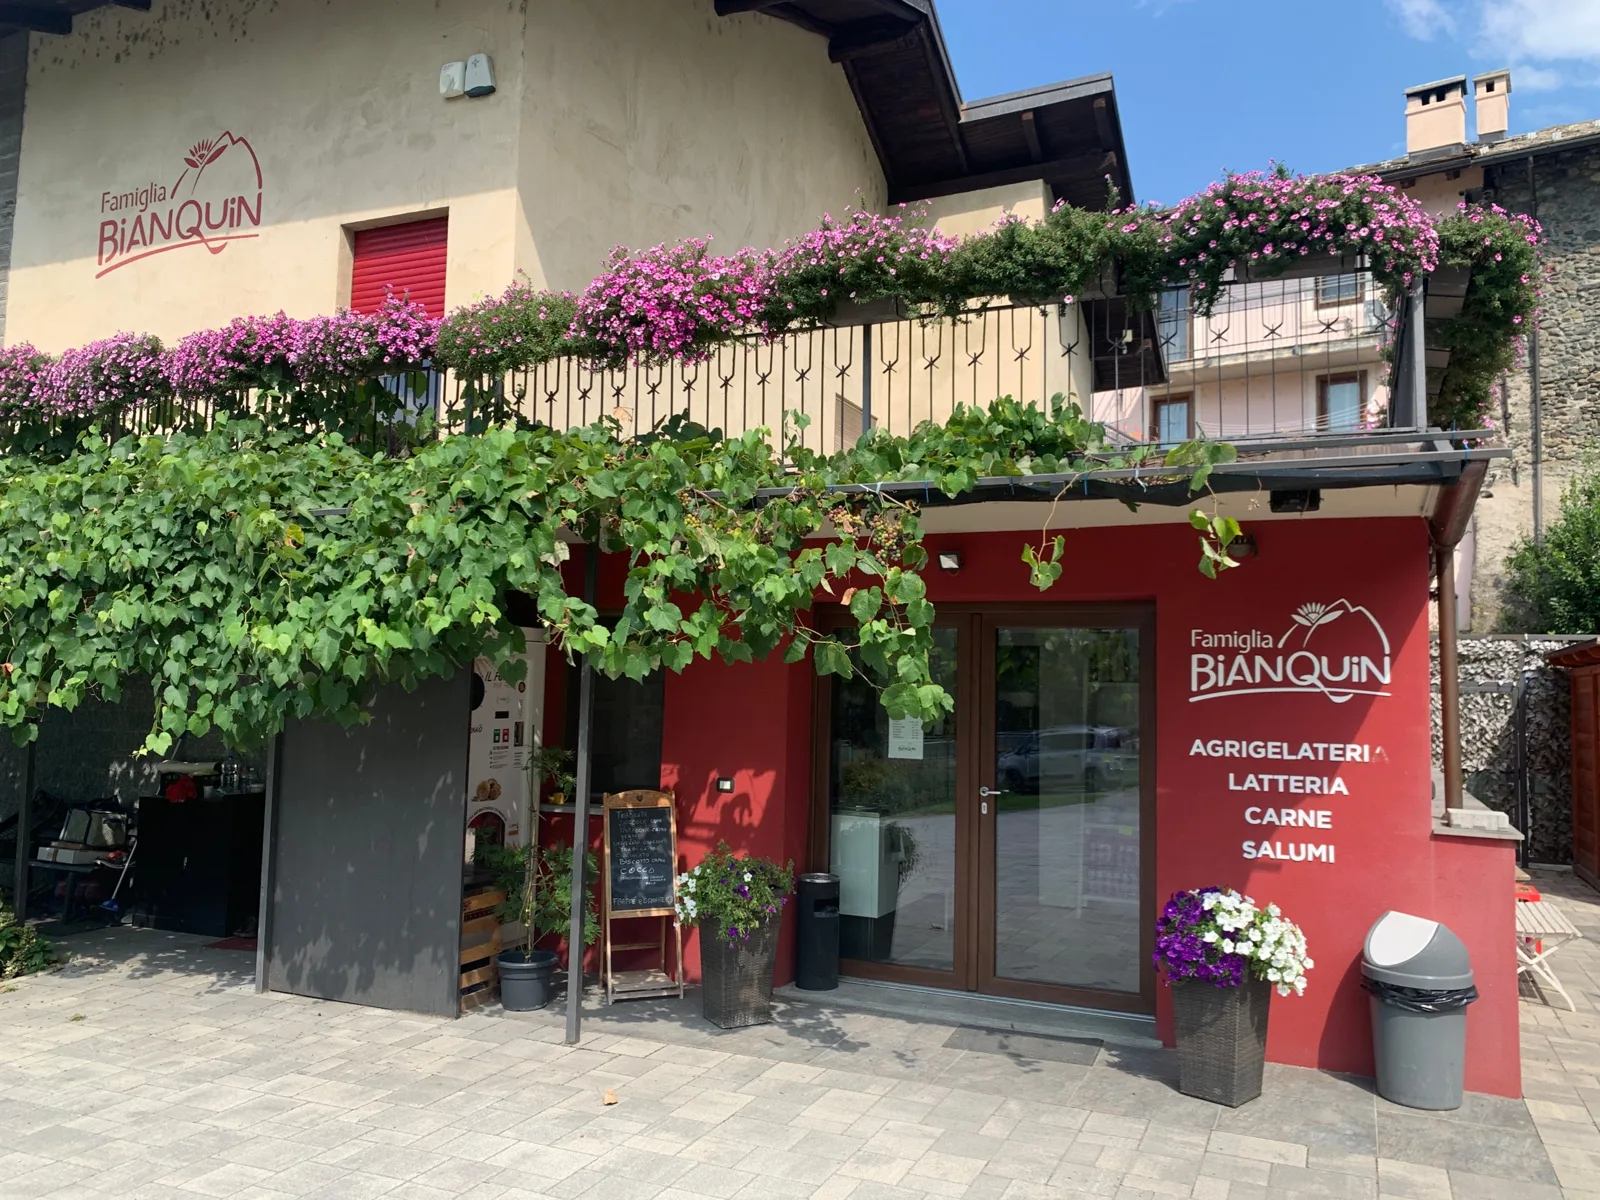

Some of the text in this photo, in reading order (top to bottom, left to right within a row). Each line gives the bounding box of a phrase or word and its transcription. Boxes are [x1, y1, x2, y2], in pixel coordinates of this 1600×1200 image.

[101, 181, 166, 213] Famiglia
[1190, 629, 1274, 653] Famiglia
[1228, 773, 1349, 795] LATTERIA
[1244, 806, 1333, 829] CARNE
[1242, 840, 1335, 864] SALUMI
[620, 867, 655, 875] COCCO
